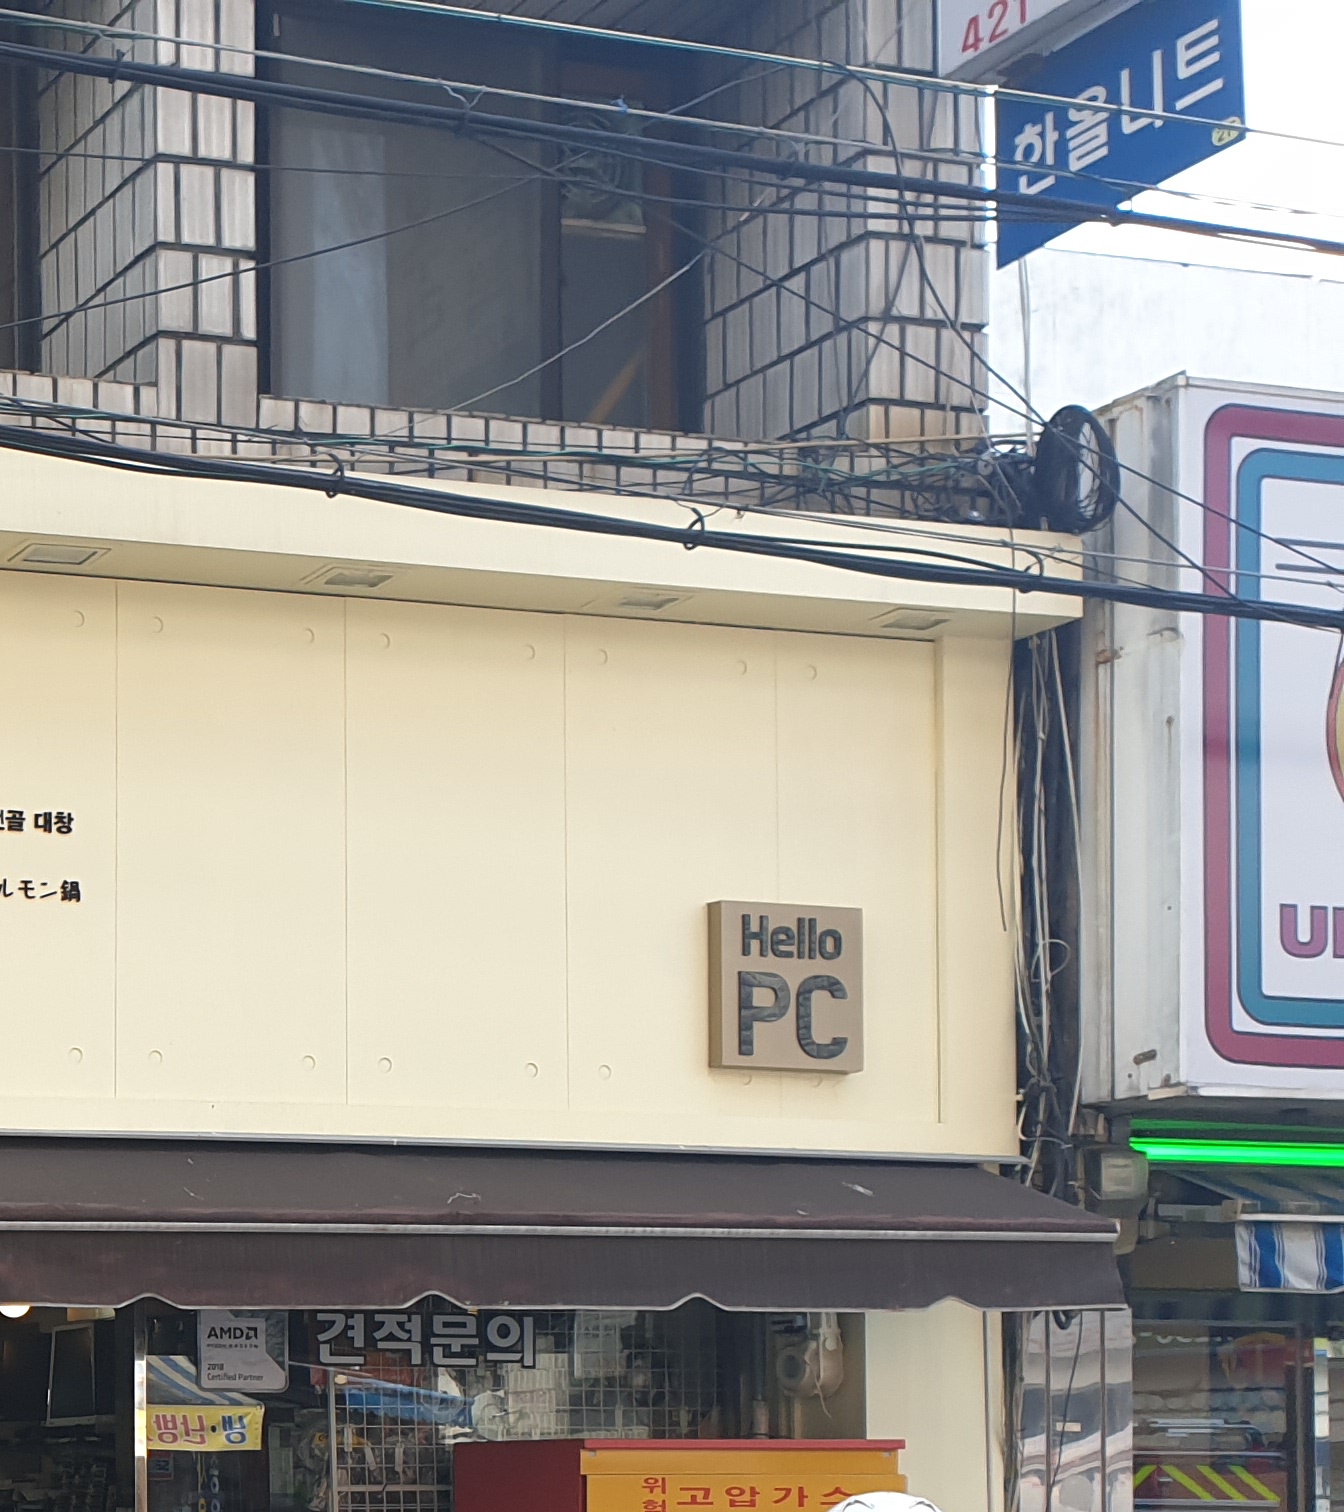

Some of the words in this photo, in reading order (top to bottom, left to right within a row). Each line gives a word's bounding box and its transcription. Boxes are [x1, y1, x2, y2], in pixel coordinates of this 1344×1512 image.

[34, 810, 75, 834] 대창
[741, 913, 843, 961] Hello
[1279, 903, 1344, 959] U
[738, 970, 849, 1060] PC
[207, 1326, 246, 1340] AMD
[316, 1312, 535, 1367] 견적문의
[207, 1373, 236, 1381] Certified
[238, 1373, 264, 1381] Partner
